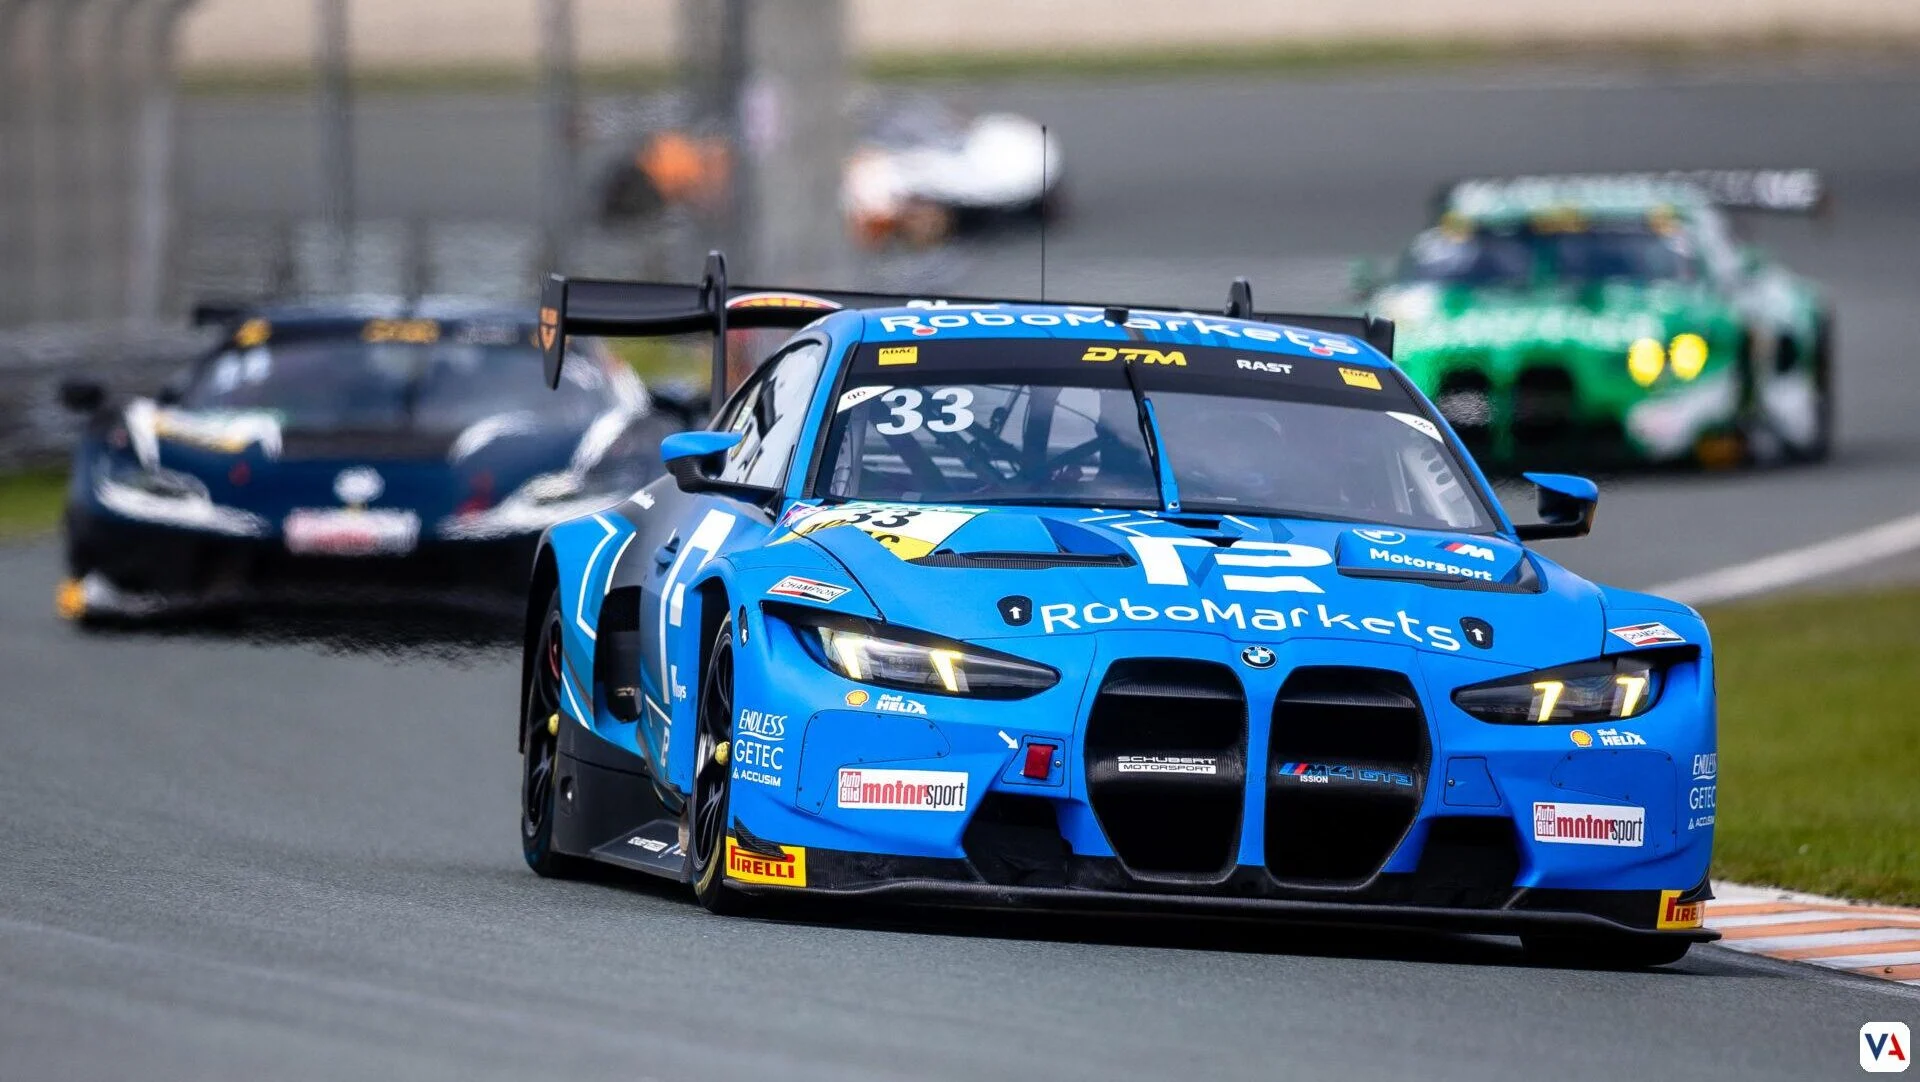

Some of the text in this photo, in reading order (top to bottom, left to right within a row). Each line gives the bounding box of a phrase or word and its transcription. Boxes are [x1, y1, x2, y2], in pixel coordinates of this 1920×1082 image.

[880, 311, 1359, 355] RoboMarkets
[1081, 346, 1187, 366] DTM
[1236, 359, 1293, 374] RAST
[876, 387, 975, 436] 33
[1369, 547, 1493, 582] Motorsport
[1041, 597, 1461, 652] RoboMarkets
[880, 693, 903, 702] Shell
[876, 699, 928, 715] HELIX
[738, 708, 788, 737] ENDLESS
[1600, 731, 1647, 746] HELIX
[734, 739, 784, 770] GETEC
[1117, 755, 1217, 765] SCHUBERT
[1122, 763, 1213, 773] MOTORSPORT
[740, 770, 782, 788] ACCUSIM
[840, 772, 861, 788] Auto
[840, 787, 861, 803] Bild
[1536, 804, 1555, 822] Auto
[1537, 821, 1555, 836] Bild
[730, 845, 796, 879] PIRELLI
